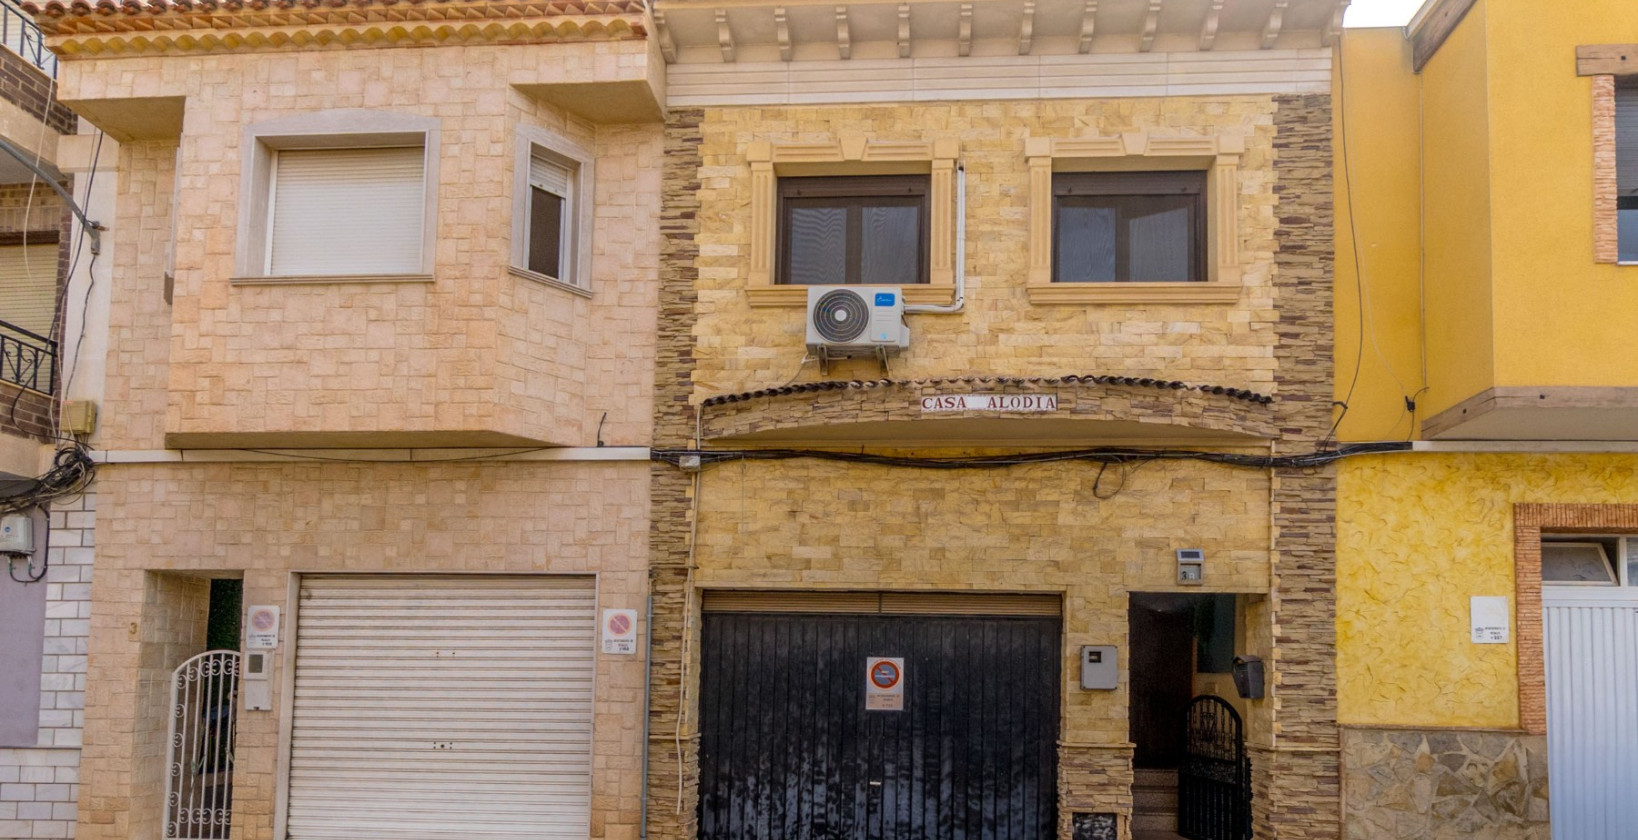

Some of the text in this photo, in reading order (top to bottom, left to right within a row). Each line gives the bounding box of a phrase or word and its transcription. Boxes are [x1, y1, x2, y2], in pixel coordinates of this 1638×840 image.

[922, 396, 1056, 409] CASA ALODIA
[130, 622, 138, 635] 3
